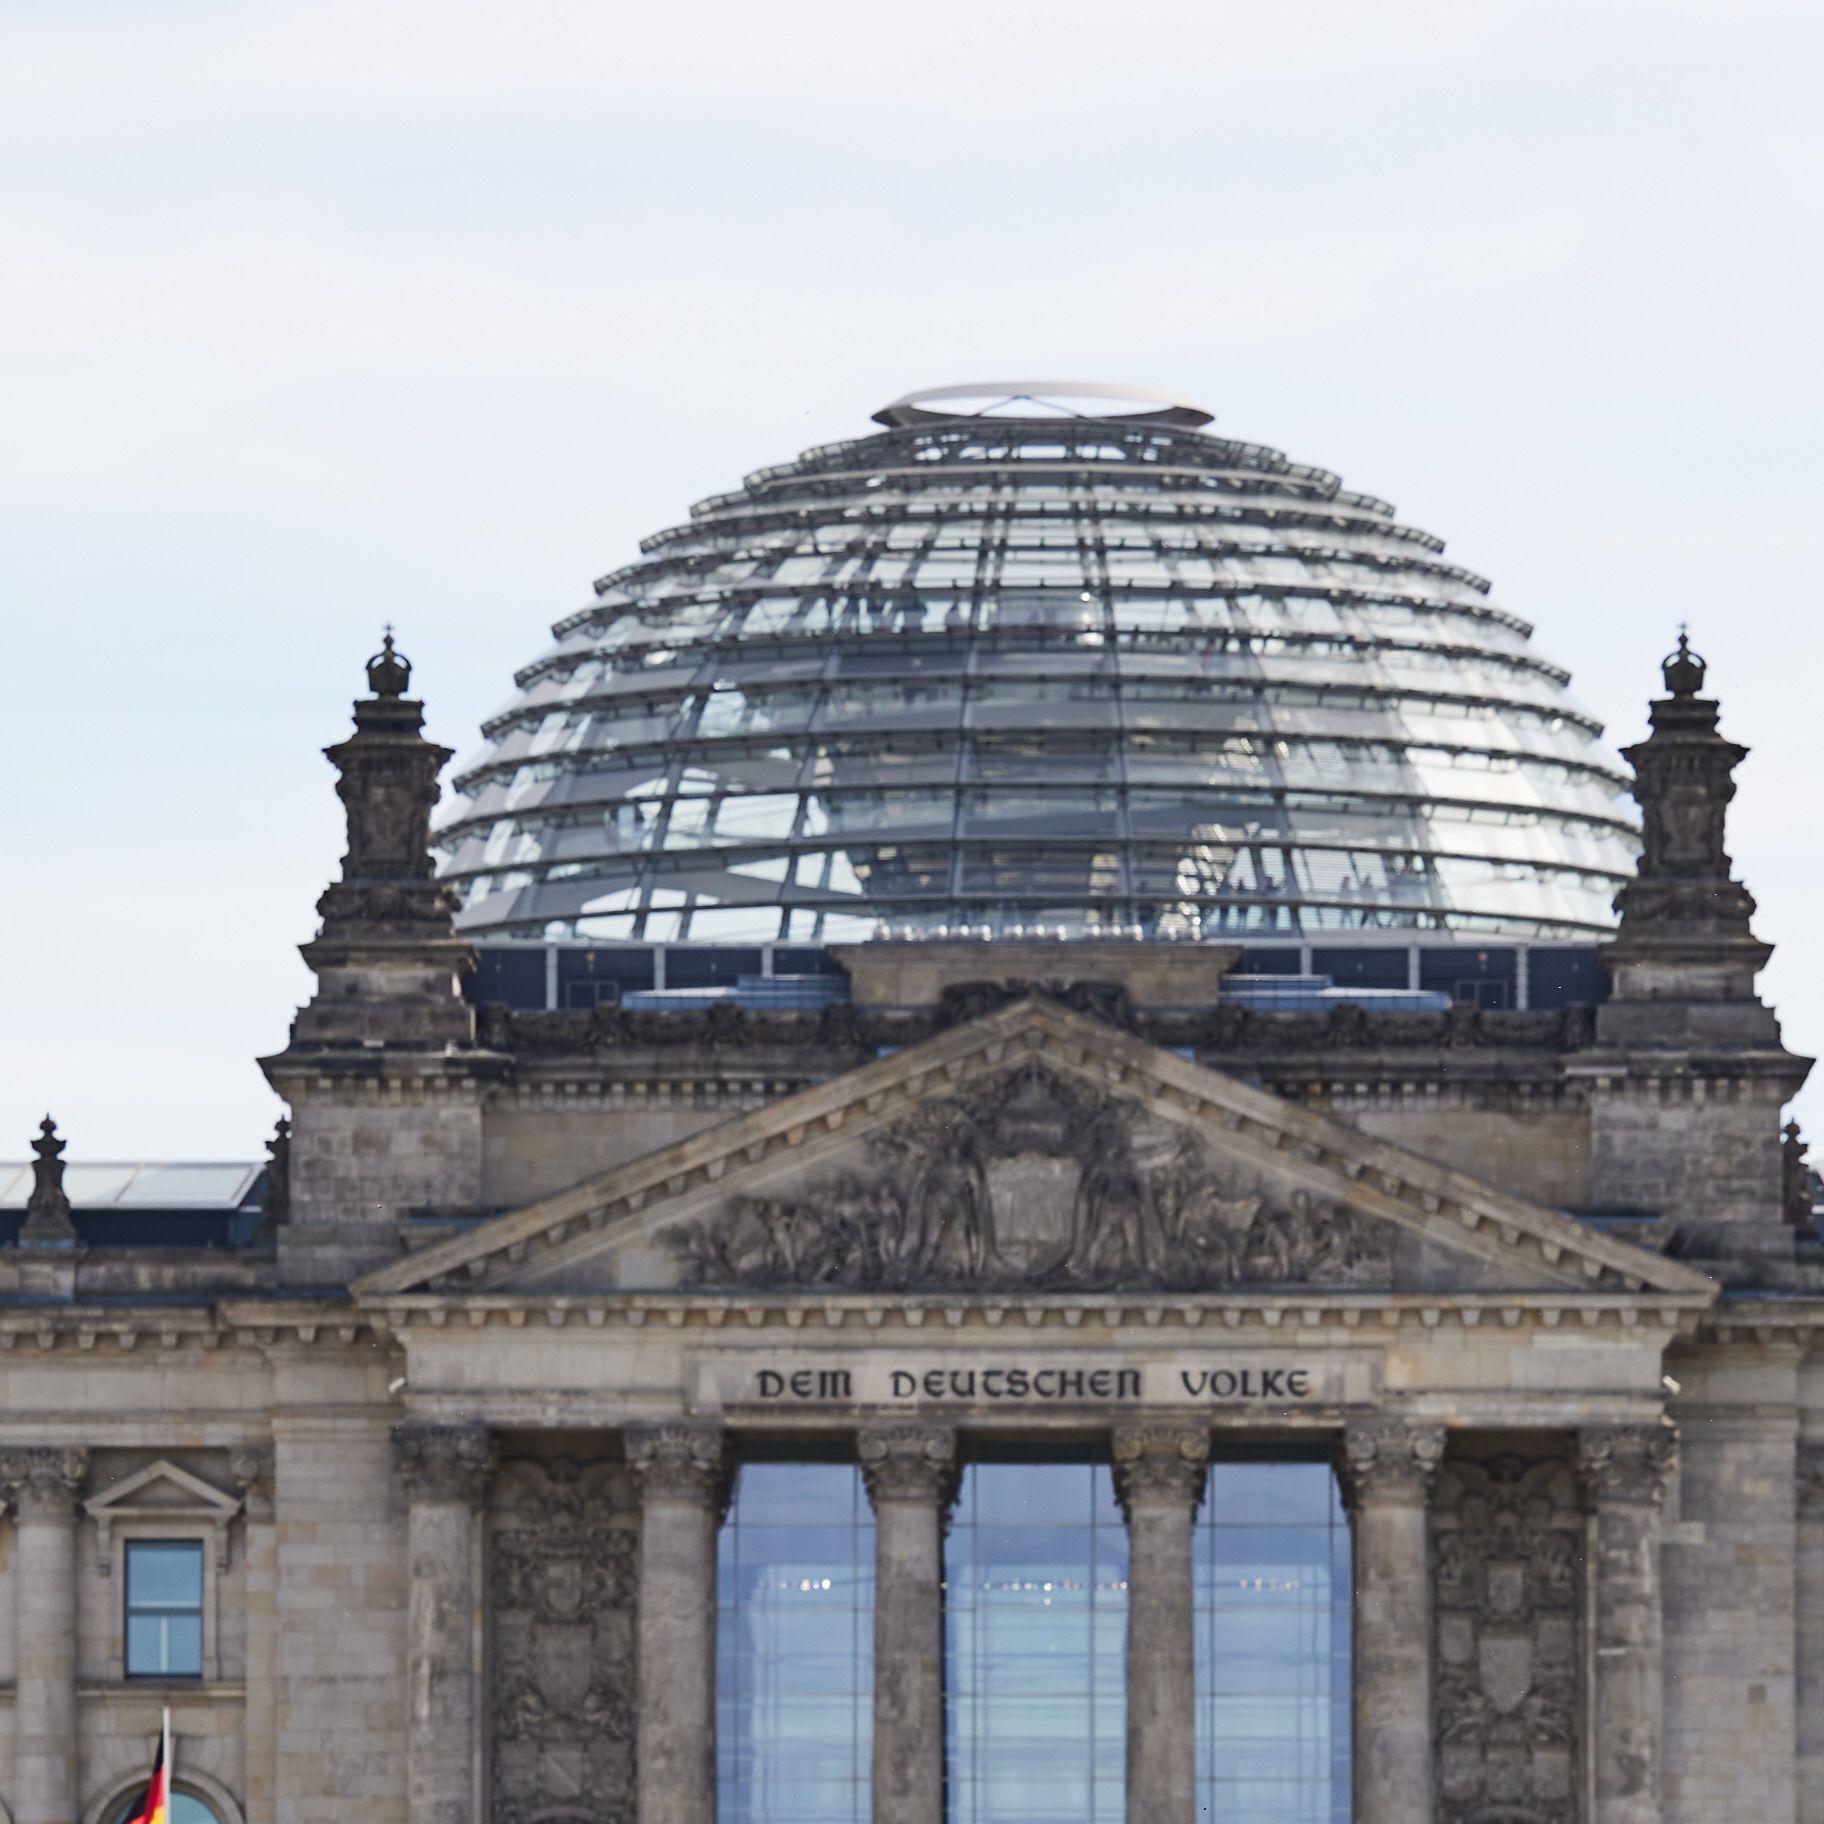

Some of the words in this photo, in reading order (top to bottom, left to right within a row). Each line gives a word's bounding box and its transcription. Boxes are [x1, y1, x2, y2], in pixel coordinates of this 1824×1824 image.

[755, 1369, 853, 1398] DEM
[890, 1369, 1141, 1398] DEUTSCHEN
[1181, 1369, 1309, 1398] VOLKE
